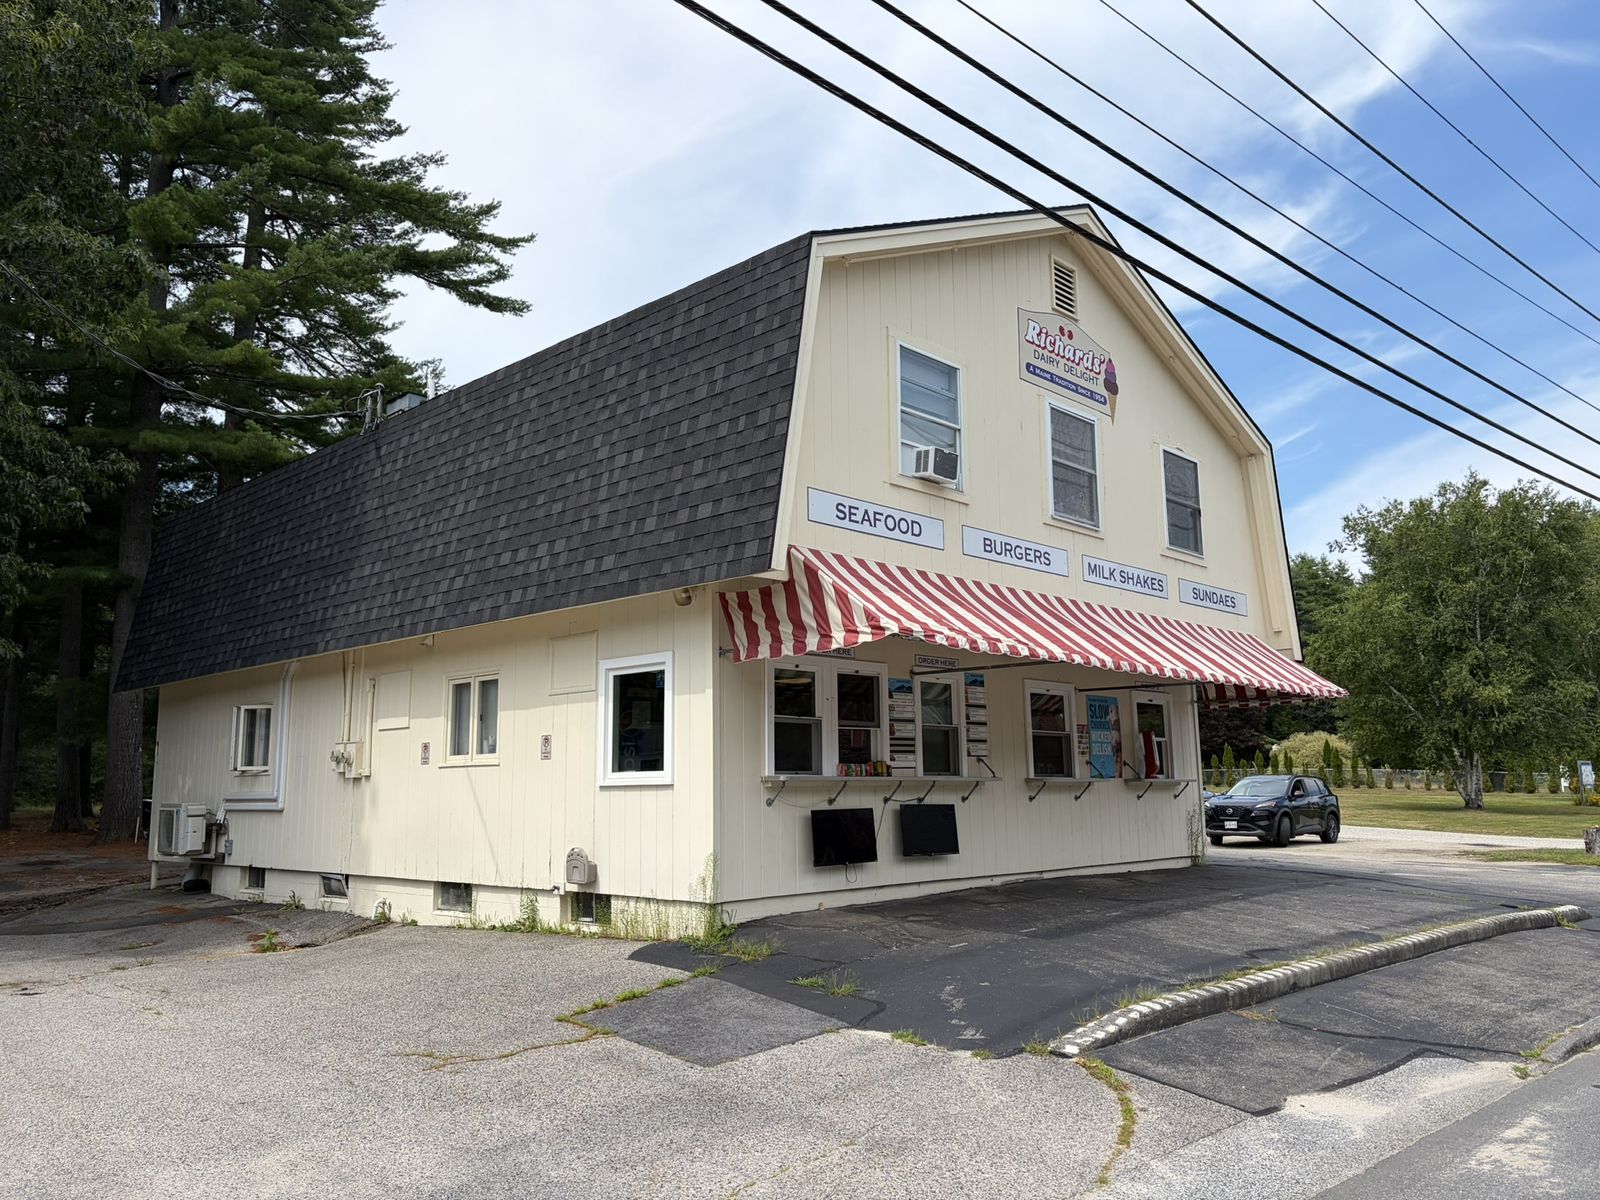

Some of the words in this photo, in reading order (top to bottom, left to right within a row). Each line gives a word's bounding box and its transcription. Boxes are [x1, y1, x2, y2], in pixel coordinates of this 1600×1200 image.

[1024, 318, 1105, 375] Richards'
[1033, 349, 1061, 369] DAIRY
[1063, 363, 1100, 387] DELIGHT
[835, 502, 922, 538] SEAFOOD
[983, 536, 1052, 567] BURGERS
[1087, 562, 1116, 582] MILK
[1119, 570, 1164, 593] SHAKES
[1192, 587, 1236, 609] SUNDAES
[918, 657, 939, 665] ORDER
[1089, 703, 1110, 720] SLOW
